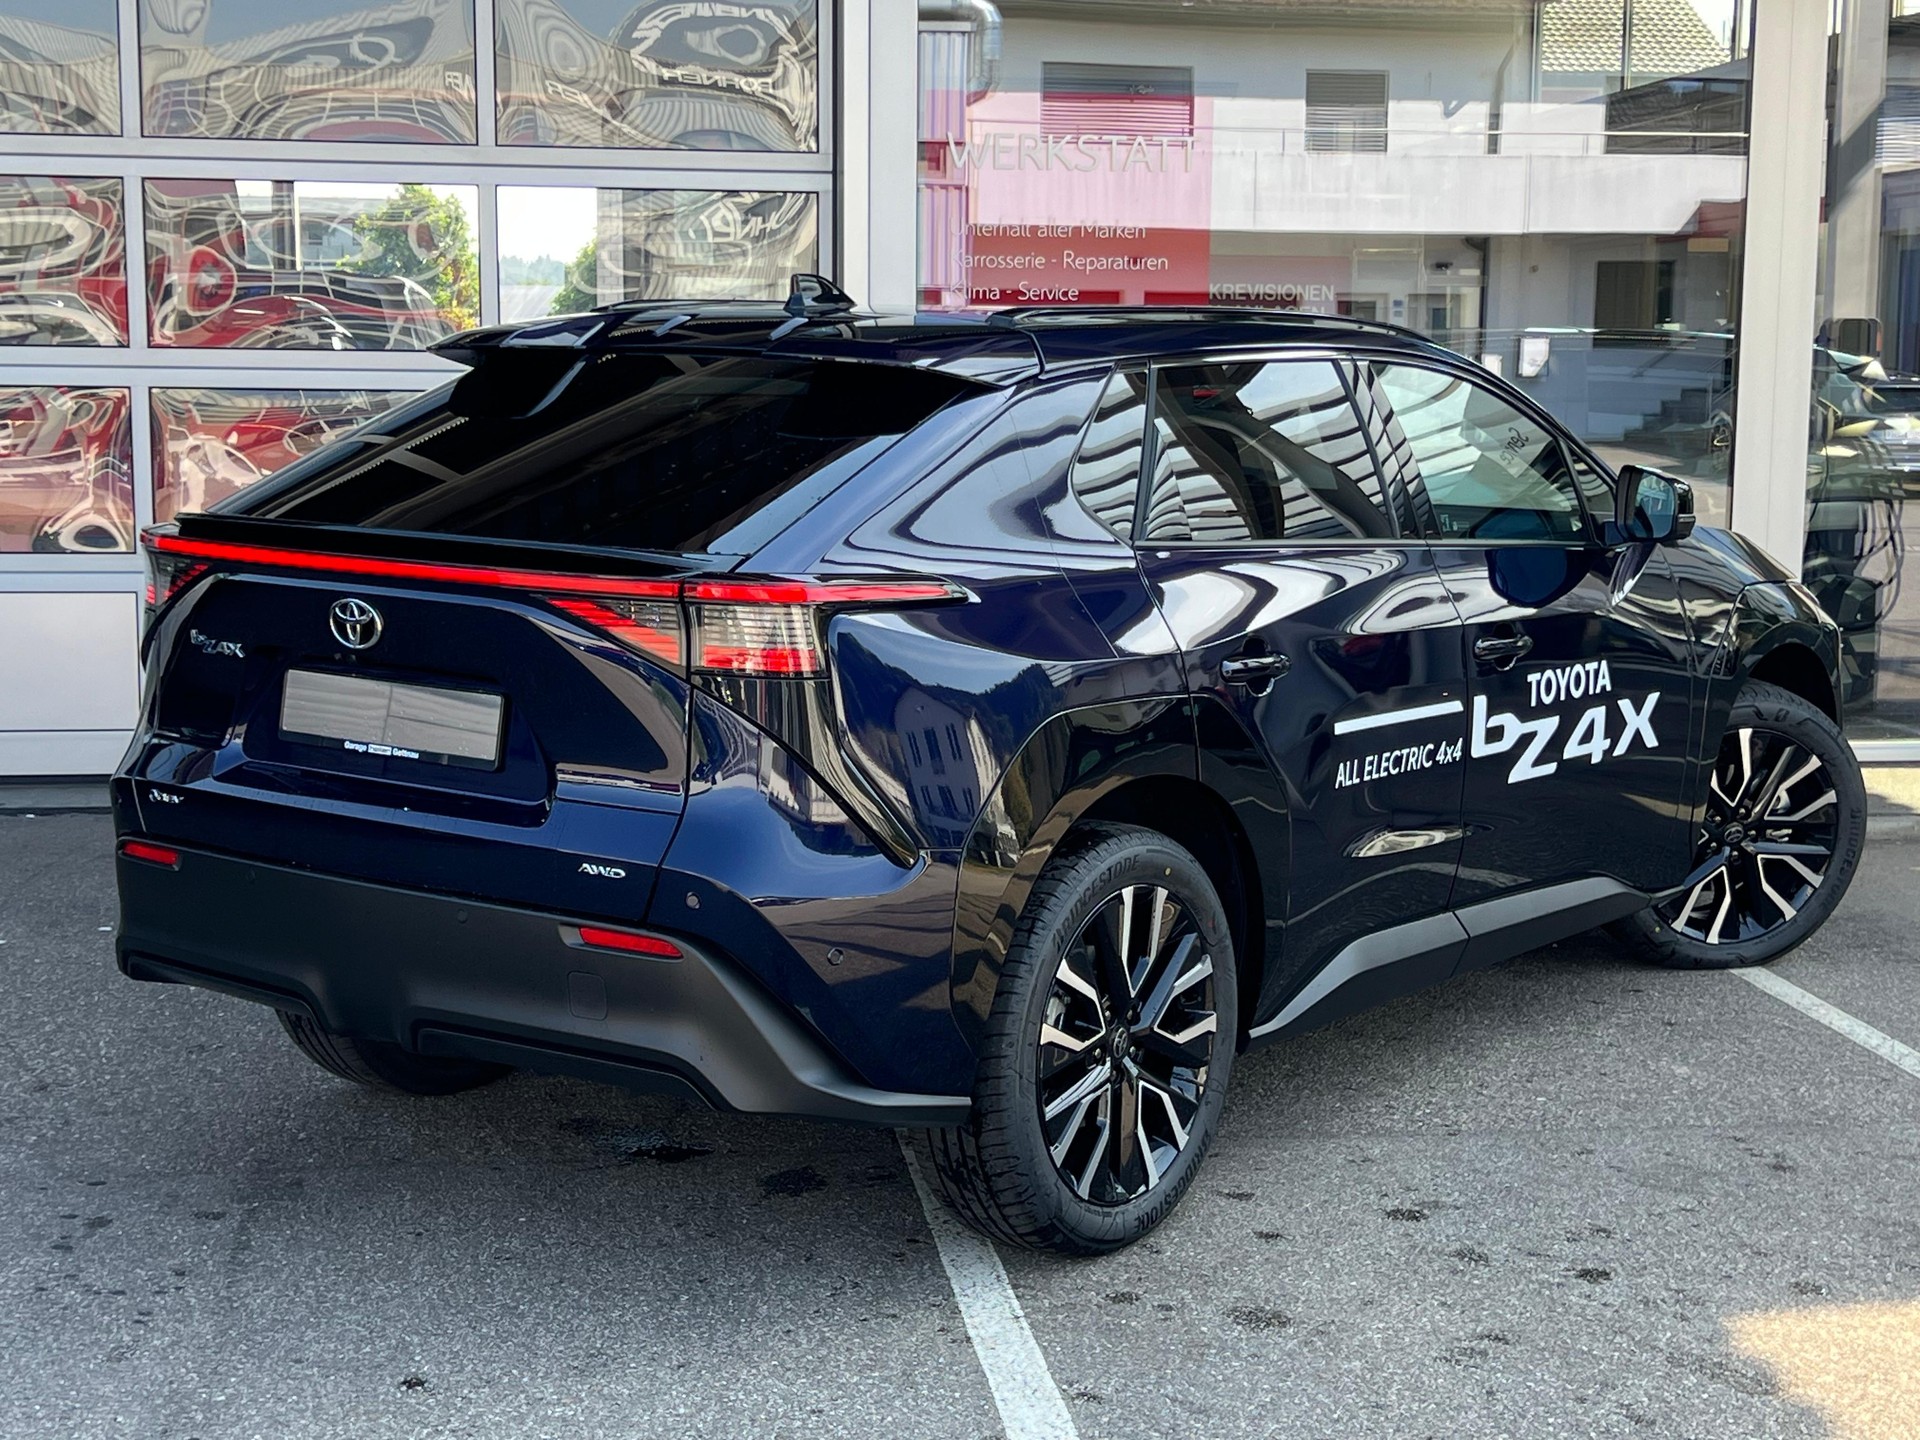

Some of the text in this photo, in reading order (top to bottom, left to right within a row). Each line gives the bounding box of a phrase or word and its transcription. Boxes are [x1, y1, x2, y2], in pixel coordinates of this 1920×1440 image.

[947, 131, 1199, 173] WERKSTATT
[950, 215, 1146, 239] Unterhalt aller Marken
[950, 249, 1046, 269] Karrosserie
[1063, 250, 1168, 274] Reparaturen
[950, 280, 1000, 301] Klima
[1018, 281, 1079, 302] Service
[1527, 659, 1612, 707] TOYOTA
[1335, 737, 1464, 790] ALL ELECTRIC 4x4
[578, 862, 626, 879] AWD
